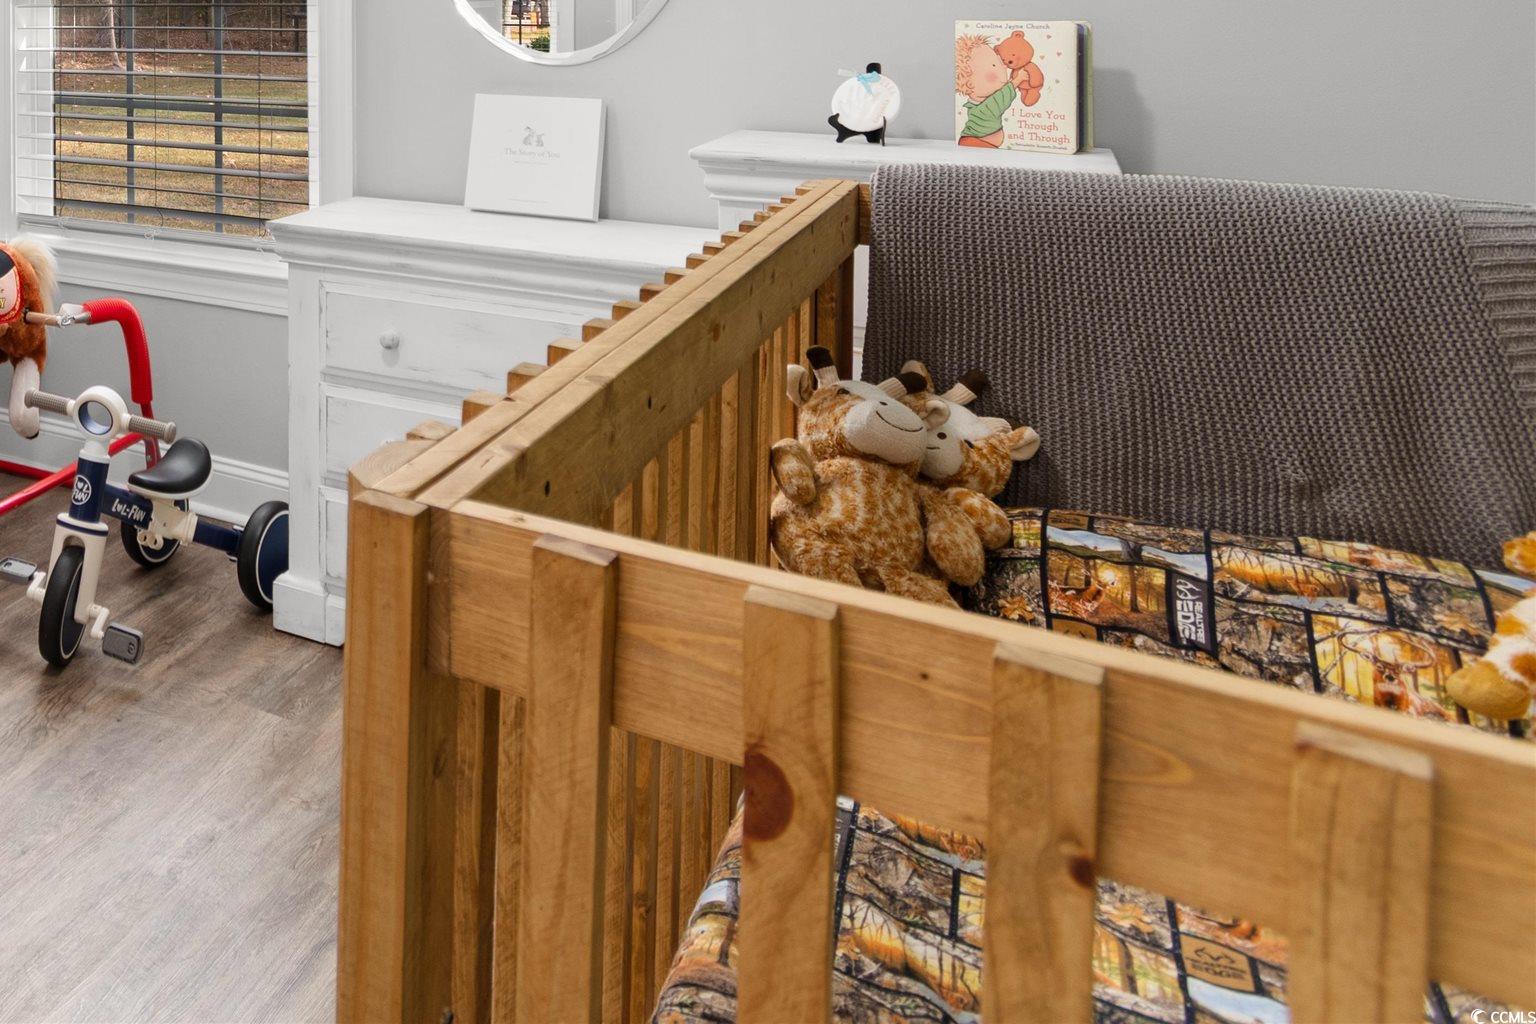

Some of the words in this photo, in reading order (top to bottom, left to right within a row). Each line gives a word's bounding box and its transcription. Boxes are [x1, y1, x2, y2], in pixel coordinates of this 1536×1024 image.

[1019, 108, 1042, 118] Love
[1045, 110, 1066, 120] You
[1017, 119, 1059, 133] Through
[1007, 131, 1024, 140] and
[1028, 132, 1071, 145] Through
